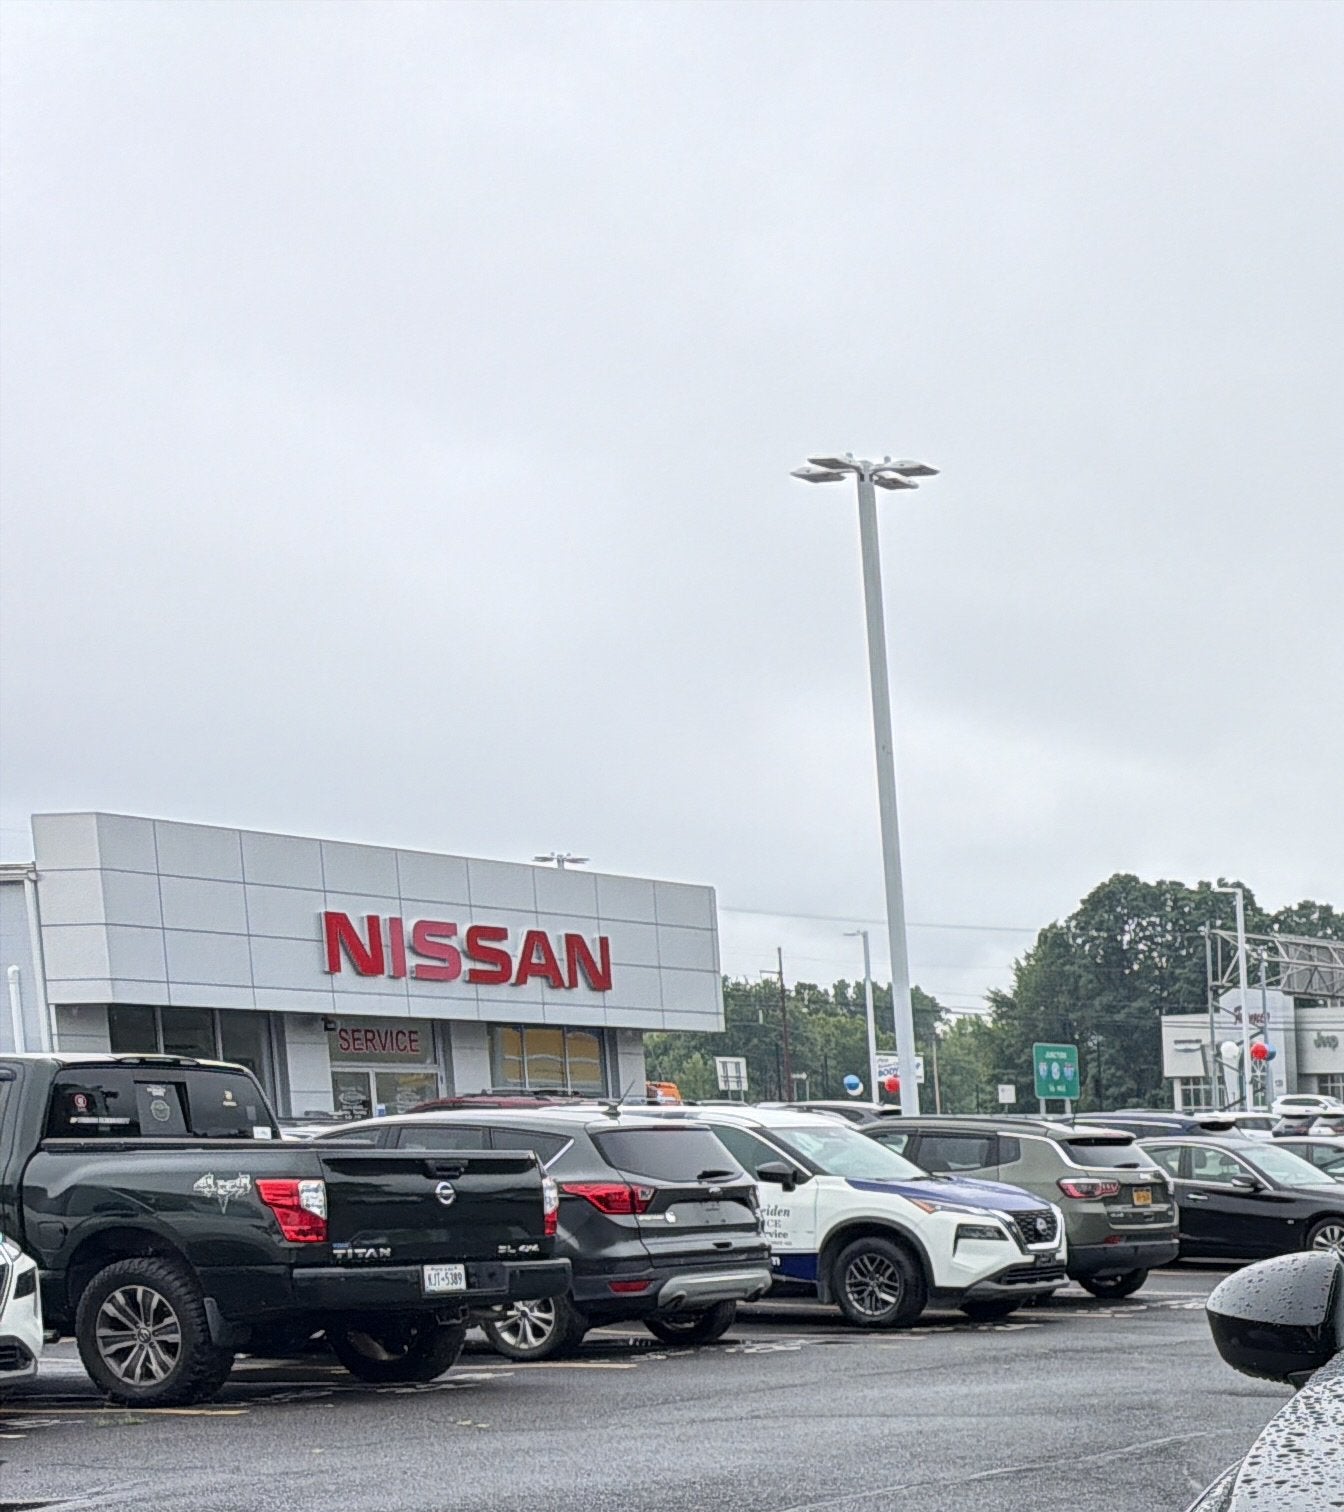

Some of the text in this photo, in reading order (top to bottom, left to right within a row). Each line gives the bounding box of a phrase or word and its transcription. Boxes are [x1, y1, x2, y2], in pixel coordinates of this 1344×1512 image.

[321, 911, 613, 991] NISSAN
[338, 1028, 420, 1053] SERVICE
[332, 1247, 392, 1260] TITAN
